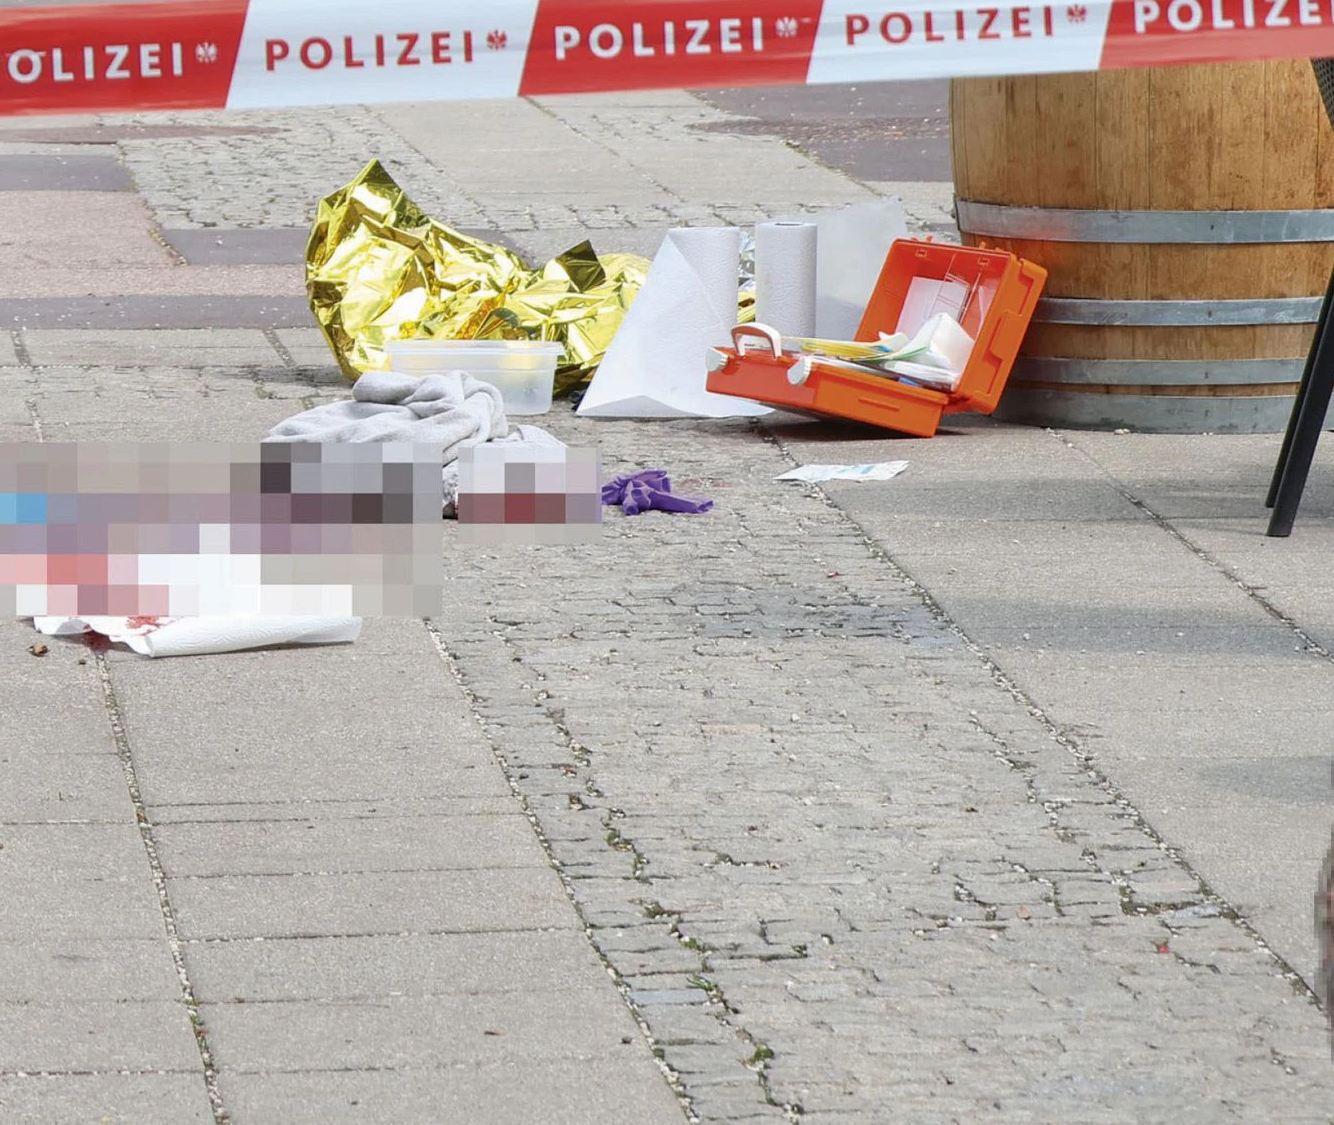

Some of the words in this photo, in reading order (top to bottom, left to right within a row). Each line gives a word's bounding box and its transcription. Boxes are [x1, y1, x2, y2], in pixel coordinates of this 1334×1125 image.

[266, 30, 473, 71] POLIZEI
[554, 17, 763, 60] POLIZEI
[846, 5, 1053, 46] POLIZEI
